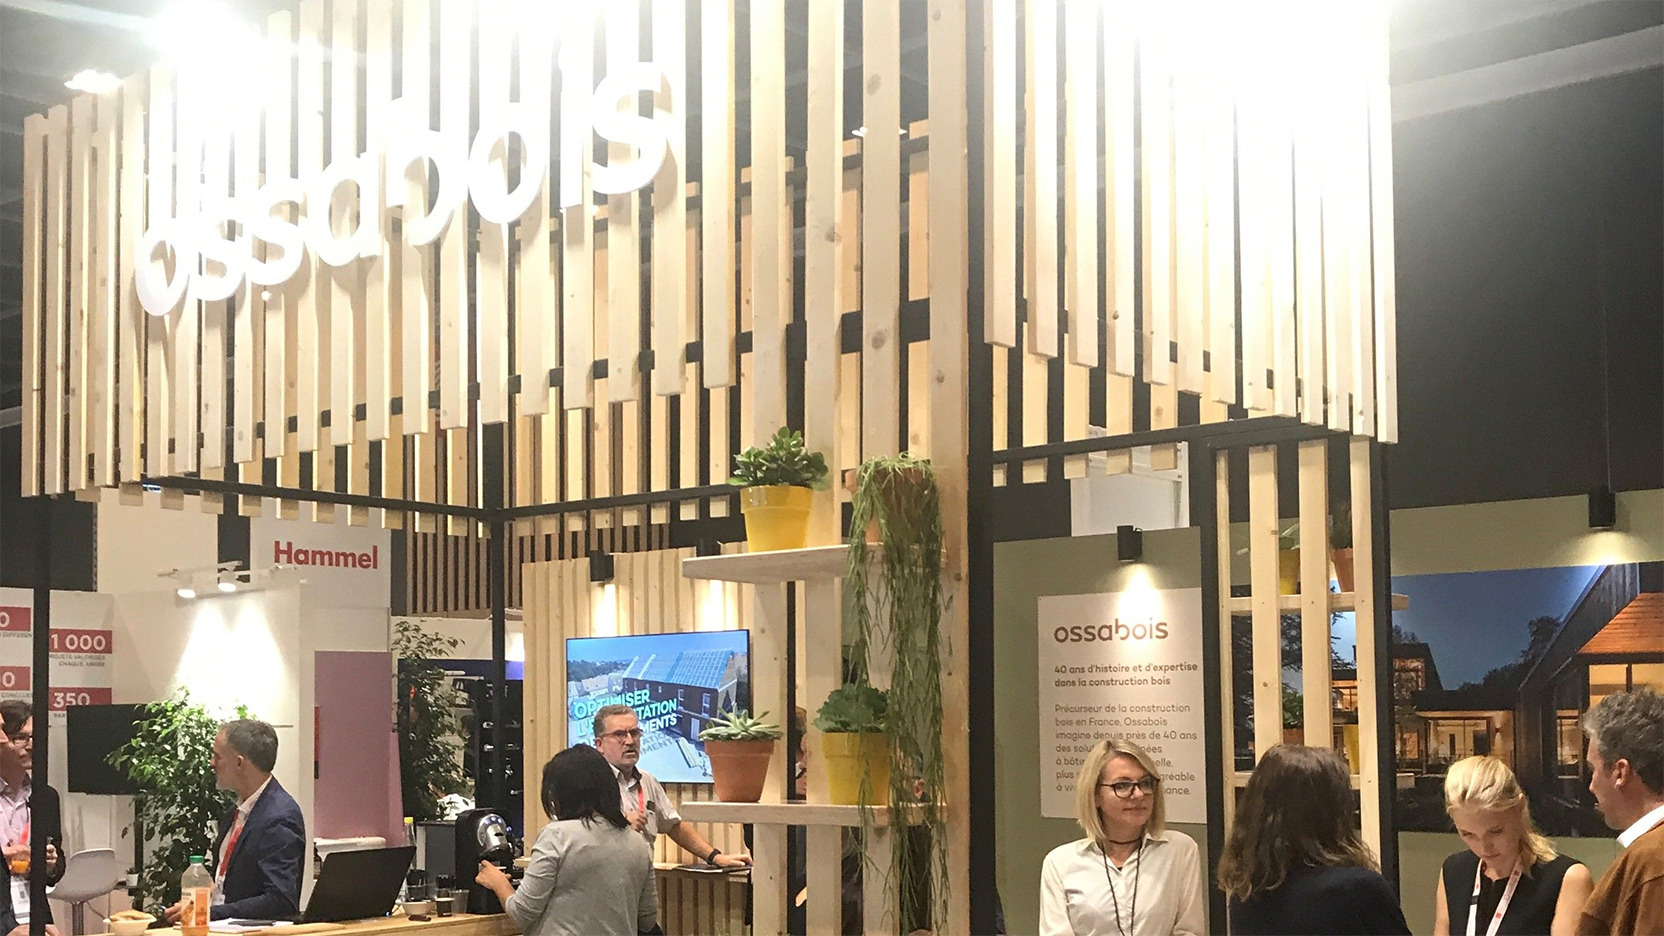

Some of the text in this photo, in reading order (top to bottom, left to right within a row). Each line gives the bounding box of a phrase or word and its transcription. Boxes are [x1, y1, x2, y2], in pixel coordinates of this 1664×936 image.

[135, 48, 680, 317] ossabois
[274, 540, 378, 570] Hammel
[1053, 617, 1169, 644] ossabois
[1054, 662, 1198, 674] 40 ans d'histoire et d'expertise
[1054, 676, 1171, 687] dans la construction bois
[53, 692, 90, 708] 350
[1055, 703, 1191, 713] Précurseur de la construction
[1055, 717, 1074, 726] bois
[1124, 717, 1168, 726] Ossabois
[1055, 730, 1197, 741] imagine depuis près de 40 ans
[1055, 744, 1072, 752] des
[1055, 757, 1062, 765] à
[1056, 770, 1075, 780] plus
[1159, 772, 1196, 783] gréable
[1056, 783, 1063, 792] à
